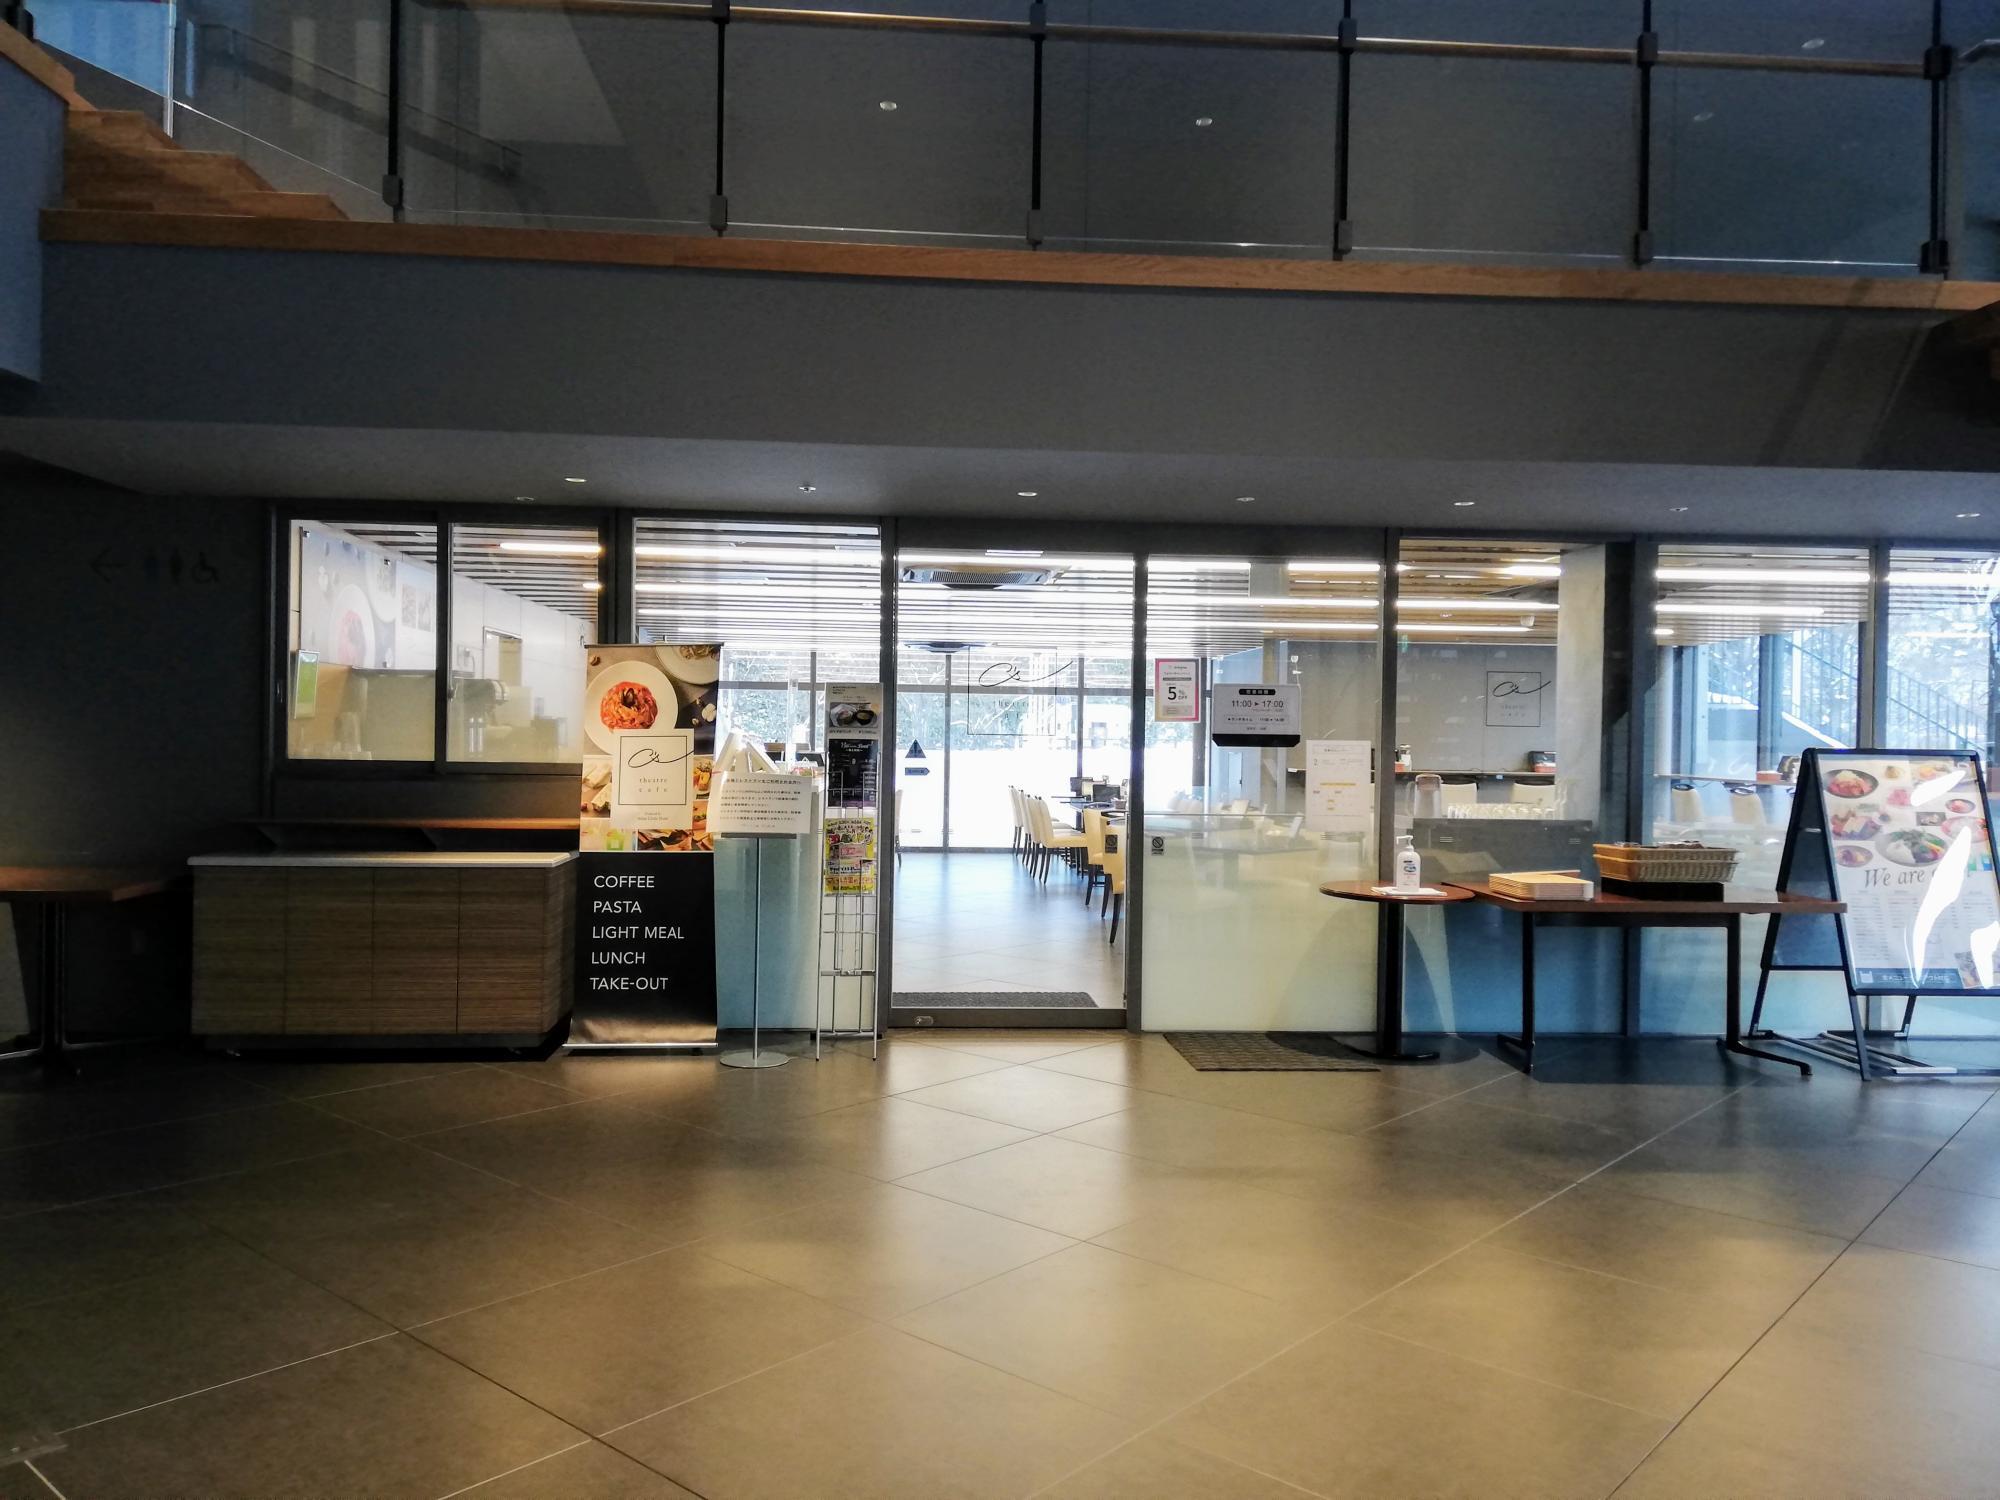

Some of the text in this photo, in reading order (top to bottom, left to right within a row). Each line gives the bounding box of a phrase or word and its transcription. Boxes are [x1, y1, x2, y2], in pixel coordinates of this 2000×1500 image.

[1232, 699, 1284, 708] 11:00 17:00
[593, 875, 656, 888] COFFEE
[1864, 867, 1892, 889] We
[1897, 870, 1925, 885] are
[592, 900, 643, 913] PASTA
[592, 926, 685, 940] LIGHT MEAL
[591, 952, 646, 965] LUNCH
[589, 977, 669, 990] TAKE-OUT
